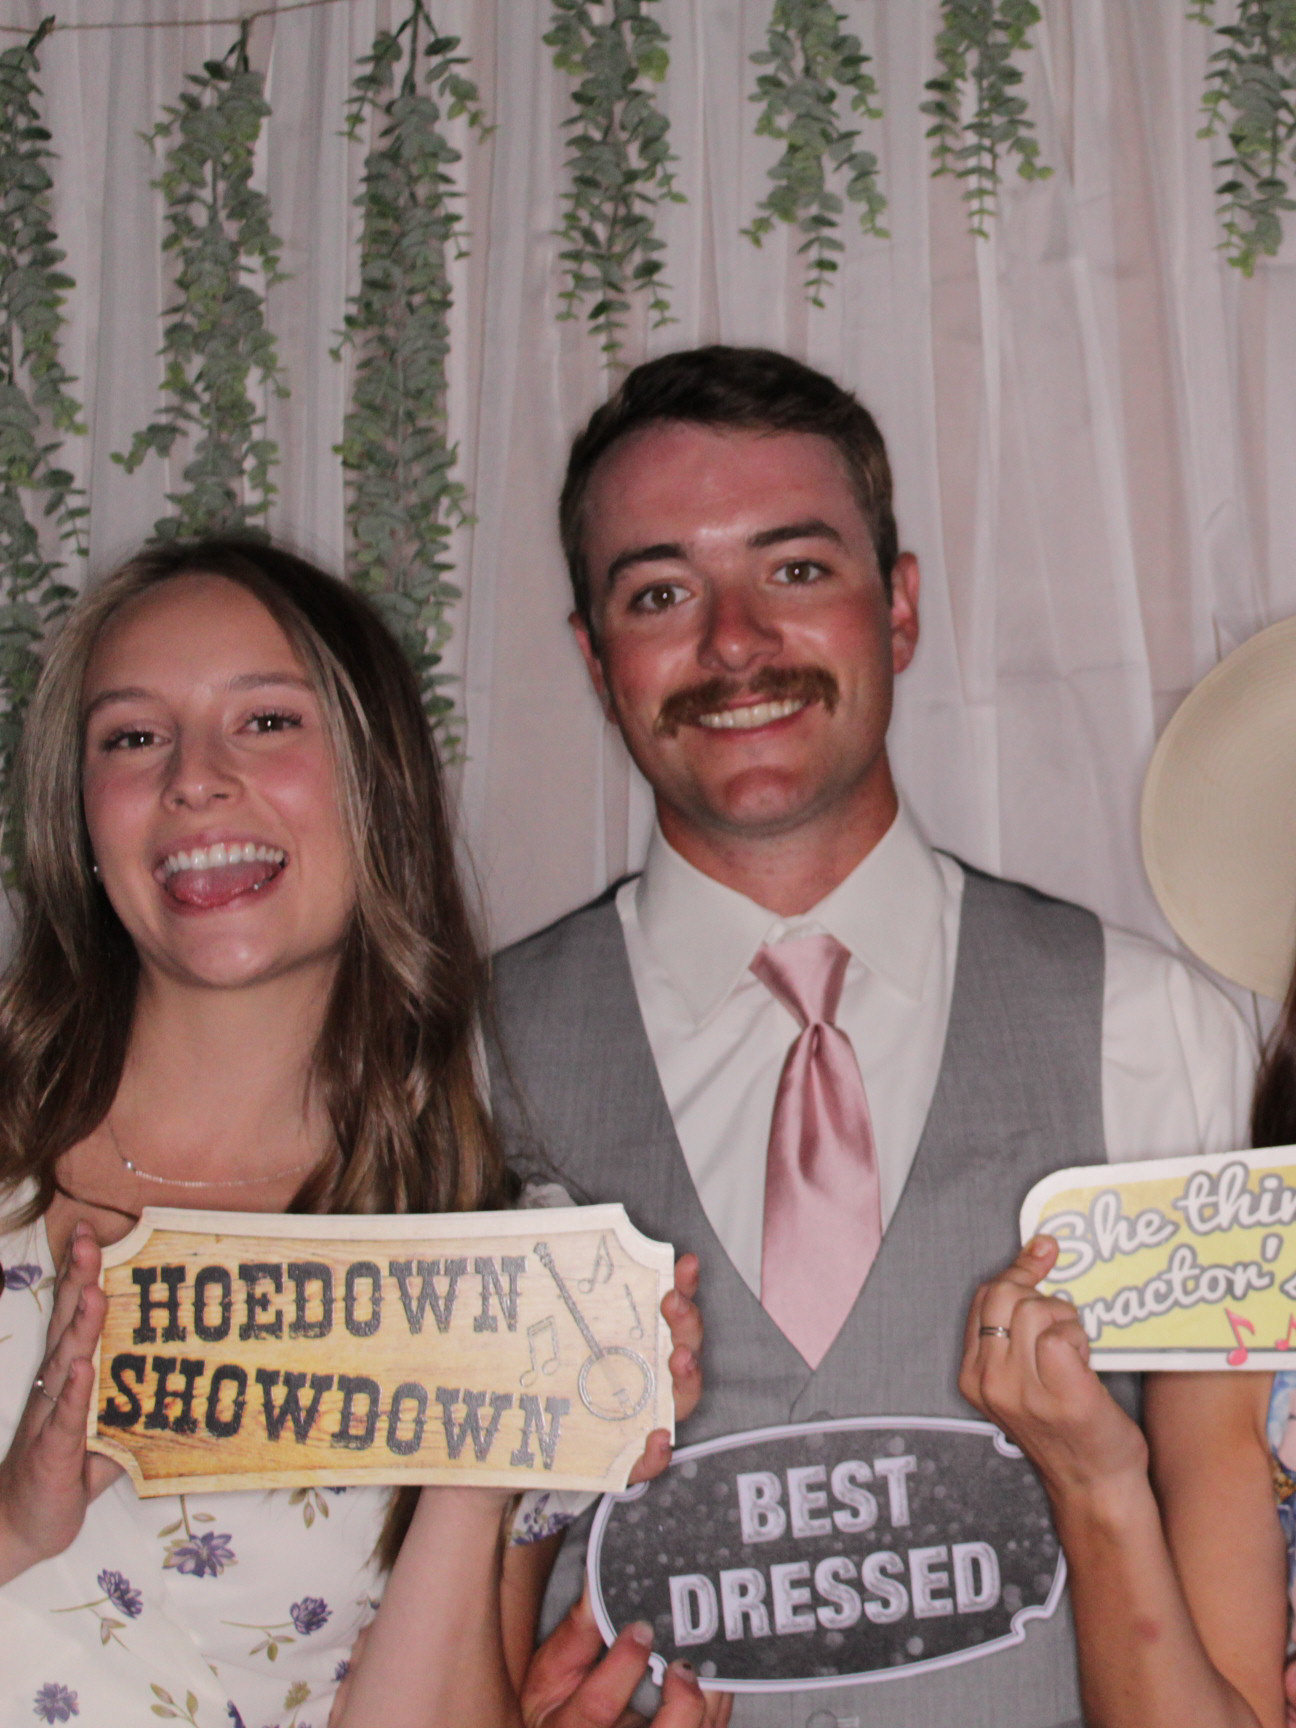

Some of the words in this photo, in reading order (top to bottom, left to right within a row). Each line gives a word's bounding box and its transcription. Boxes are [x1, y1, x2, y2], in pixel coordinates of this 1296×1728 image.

[1038, 1191, 1178, 1282] She
[131, 1255, 528, 1345] HOEDOWN
[97, 1353, 571, 1470] SHOWDOWN
[736, 1454, 918, 1544] BEST
[669, 1541, 1000, 1647] DRESSED
